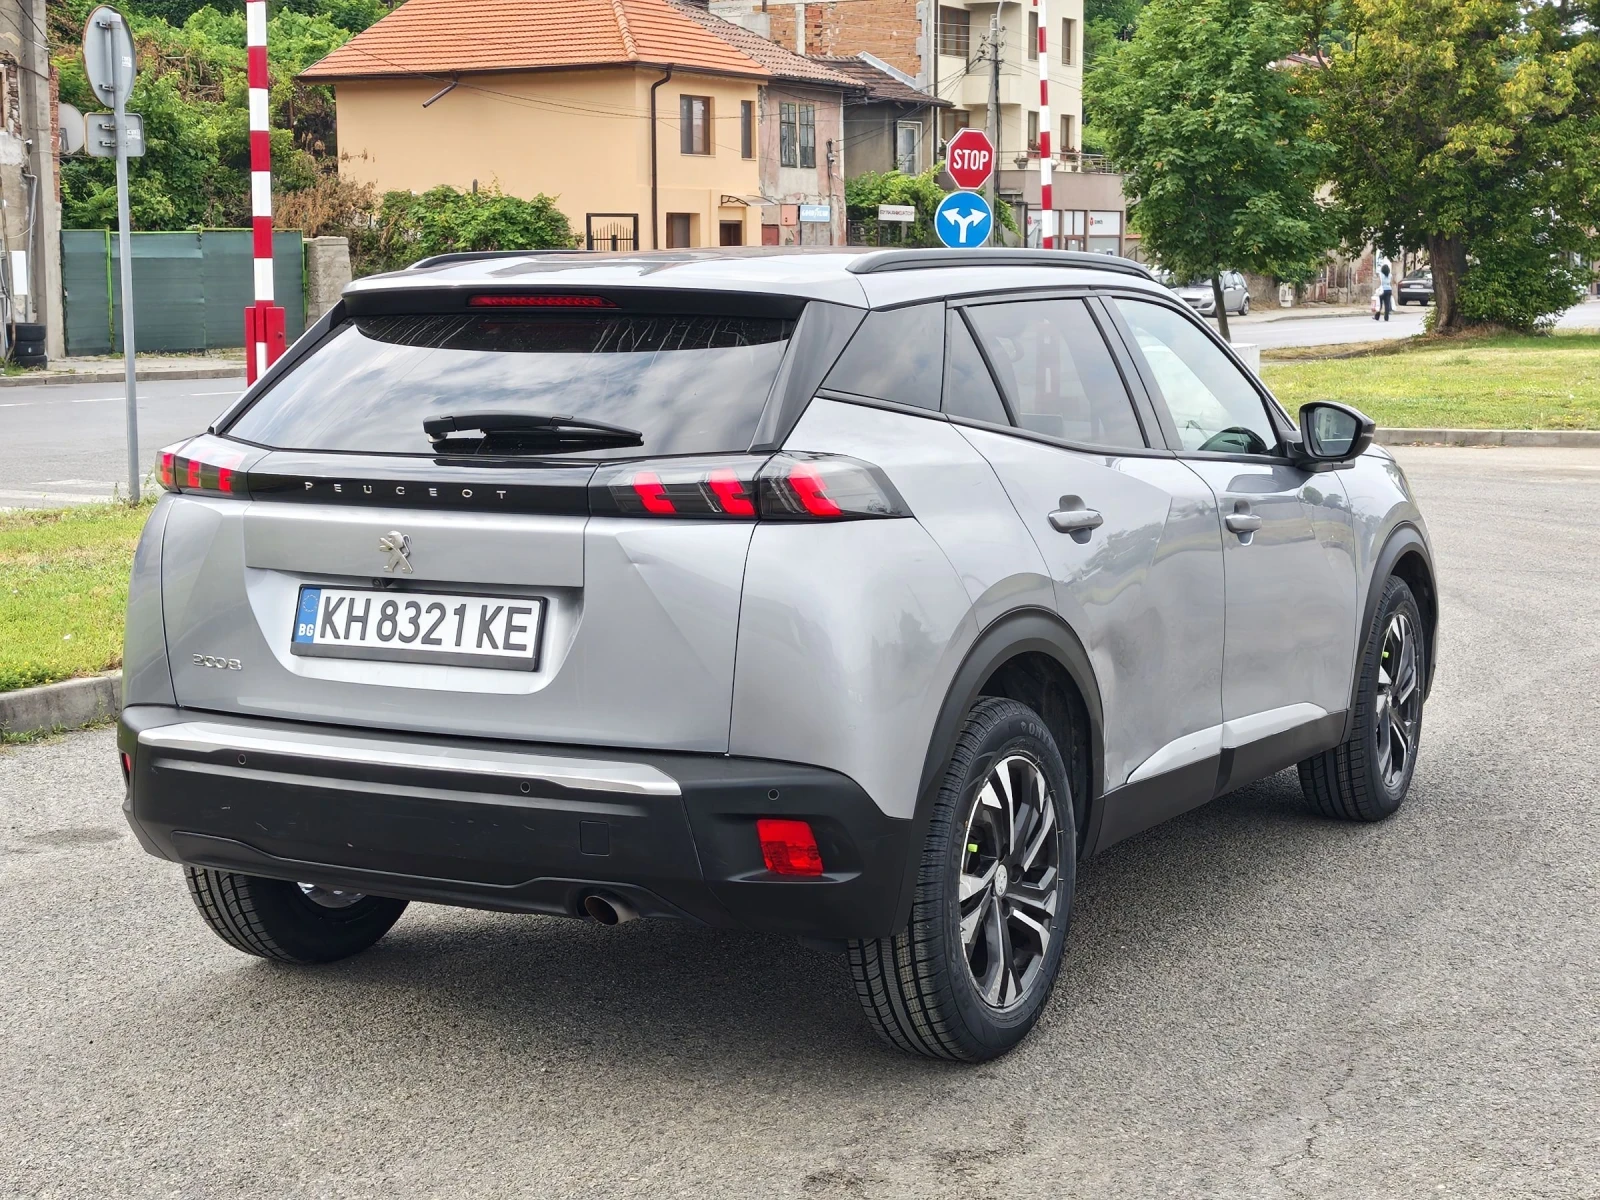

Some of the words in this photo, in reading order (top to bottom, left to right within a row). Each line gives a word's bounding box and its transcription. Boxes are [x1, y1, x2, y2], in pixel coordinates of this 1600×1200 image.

[952, 148, 990, 171] STOP
[304, 481, 507, 500] PEUGEOT
[298, 623, 315, 637] BG
[319, 596, 372, 641] KH
[376, 600, 467, 647] 8321
[476, 604, 532, 652] KE
[192, 653, 242, 671] 2008
